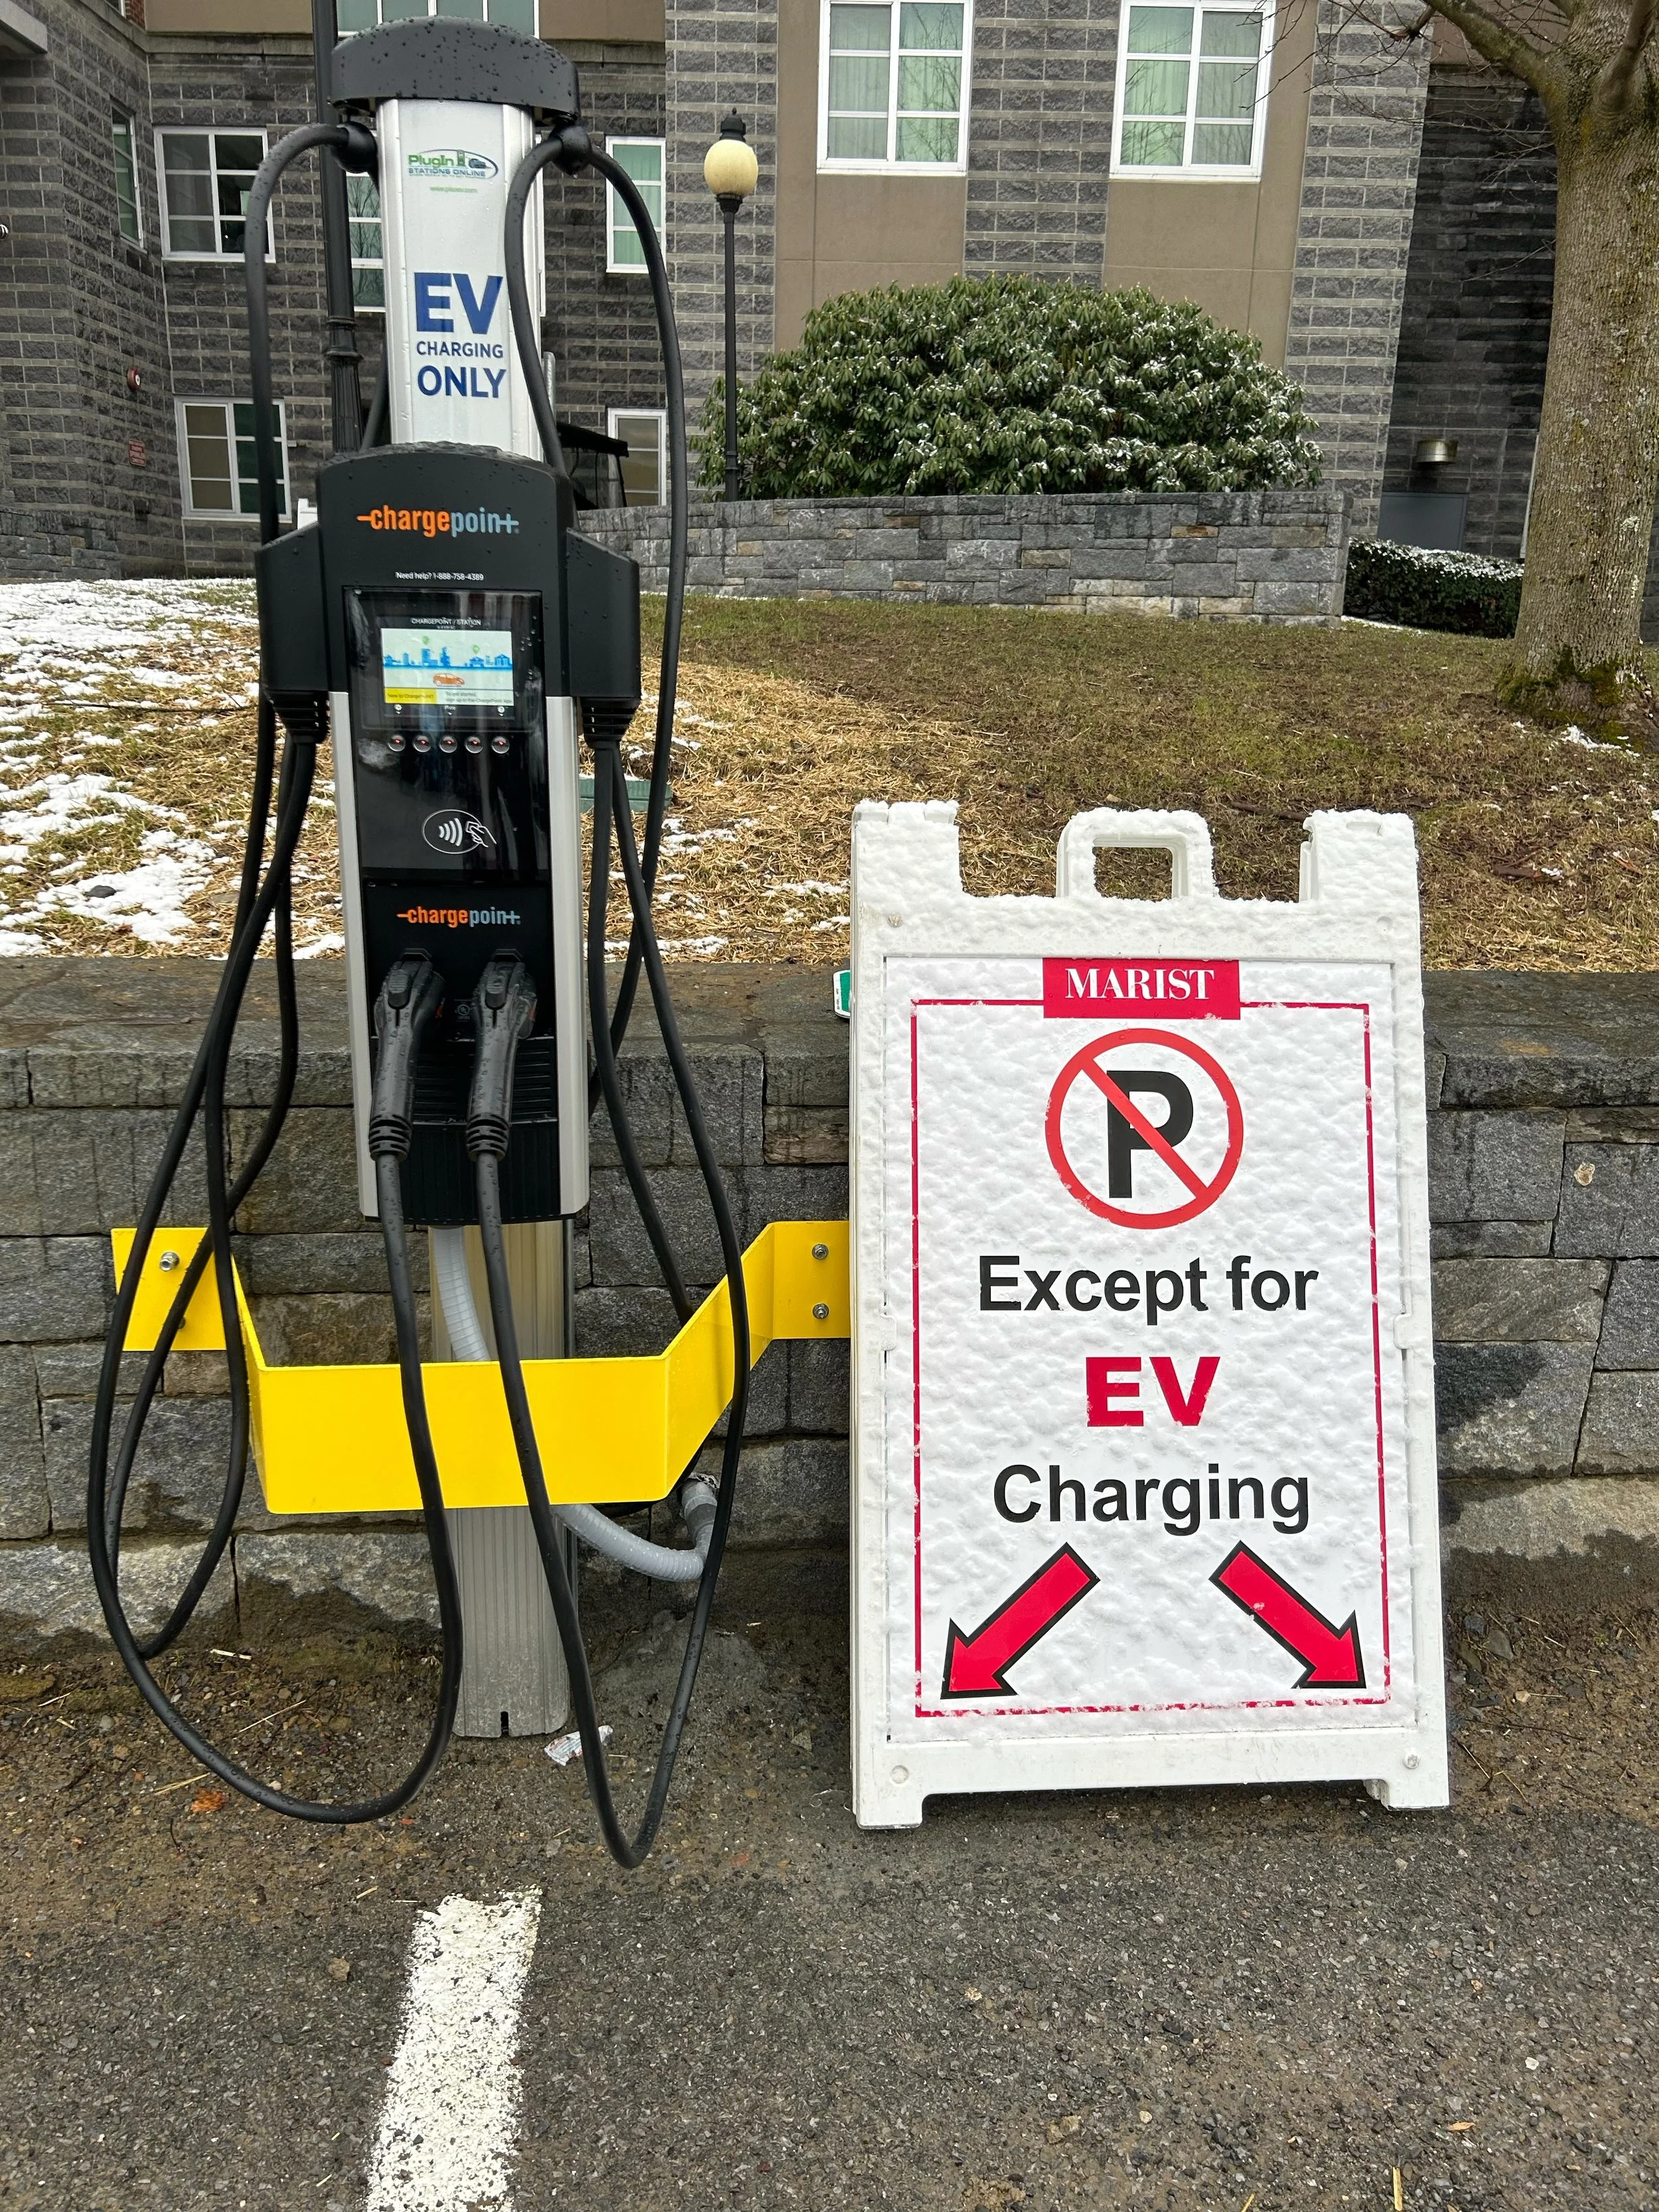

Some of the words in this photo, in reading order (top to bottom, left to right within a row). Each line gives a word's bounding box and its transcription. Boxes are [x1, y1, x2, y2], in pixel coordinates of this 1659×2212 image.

[408, 154, 455, 169] PlugIn
[414, 272, 504, 334] EV
[417, 340, 504, 358] CHARGING
[417, 365, 507, 398] ONLY
[414, 571, 432, 580] help?
[433, 572, 484, 581] 1-888-758-4389
[1065, 968, 1214, 999] MARIST
[1106, 1070, 1194, 1199] P
[979, 1255, 1209, 1326] Except
[1226, 1255, 1319, 1312] for
[1086, 1357, 1220, 1427] EV
[993, 1463, 1309, 1536] Charging
